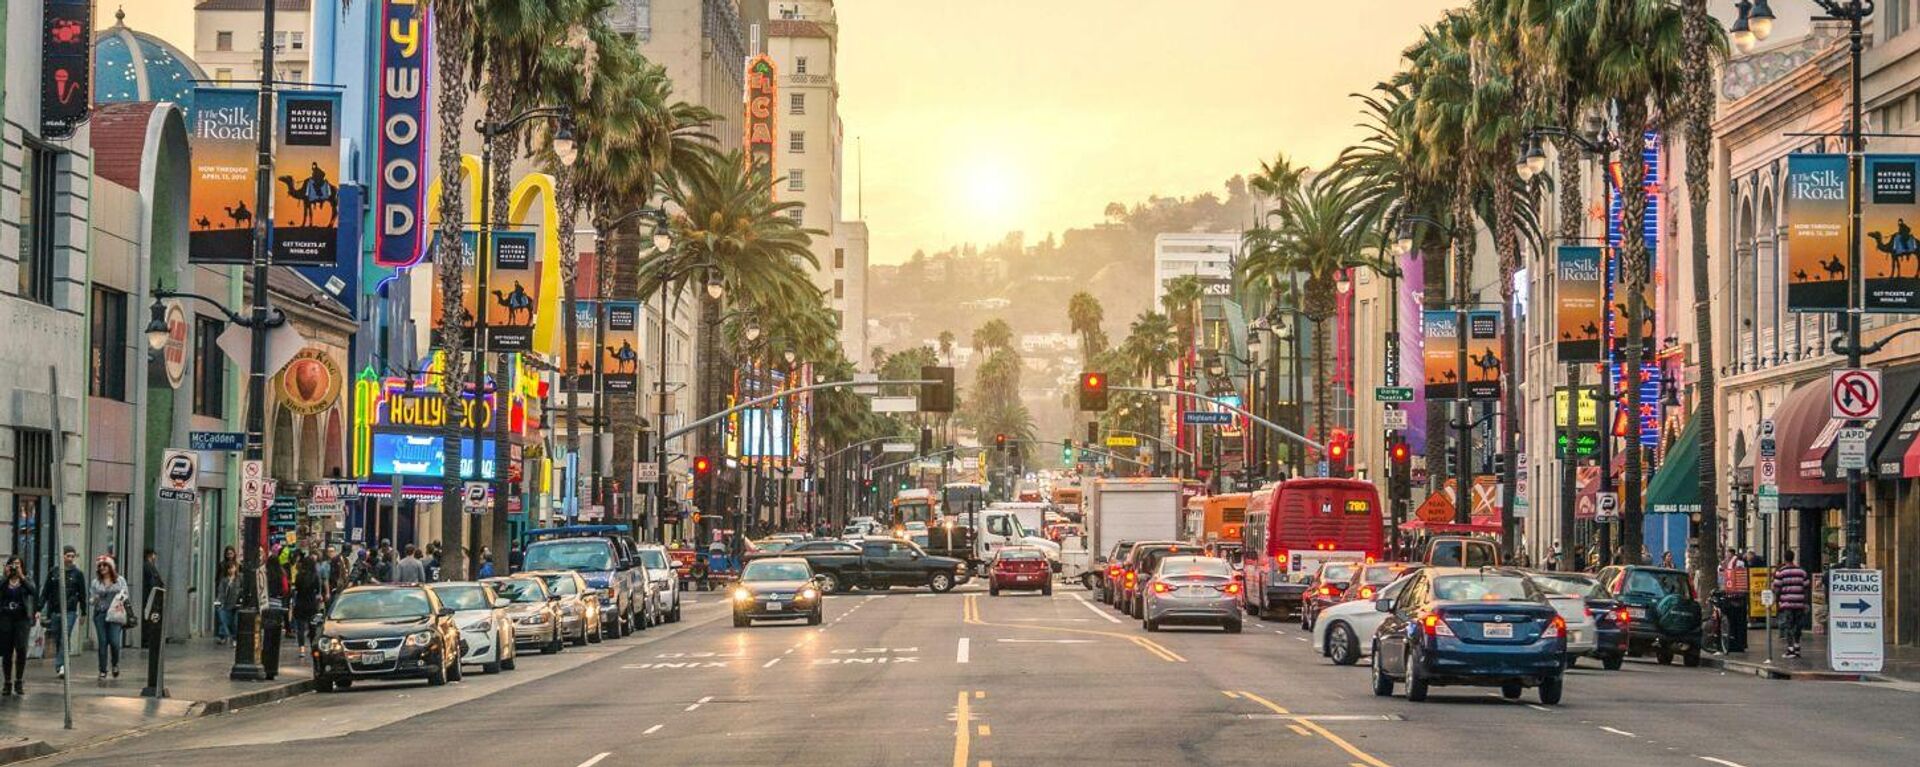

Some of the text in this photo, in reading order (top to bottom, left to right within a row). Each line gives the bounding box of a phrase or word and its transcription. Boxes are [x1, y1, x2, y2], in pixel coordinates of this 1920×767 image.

[204, 110, 218, 119] The
[218, 107, 250, 126] Silk
[291, 109, 328, 117] NATURAL
[385, 0, 420, 236] YWOOD
[204, 119, 254, 139] Road
[1800, 173, 1811, 181] The
[1811, 170, 1839, 187] Silk
[1799, 181, 1845, 200] Road
[1574, 258, 1595, 271] Silk
[1565, 267, 1598, 281] Road
[1437, 319, 1453, 329] Silk
[1429, 327, 1456, 337] Road
[390, 394, 491, 429] HOLLYOOD
[192, 432, 236, 443] McCadden
[1839, 431, 1865, 439] LAPD
[315, 486, 337, 497] ATM
[309, 503, 344, 511] INTERNET
[1832, 574, 1879, 583] PUBLIC
[1832, 584, 1880, 592] PARKING
[1836, 621, 1848, 629] PARK
[1864, 621, 1877, 629] WALK
